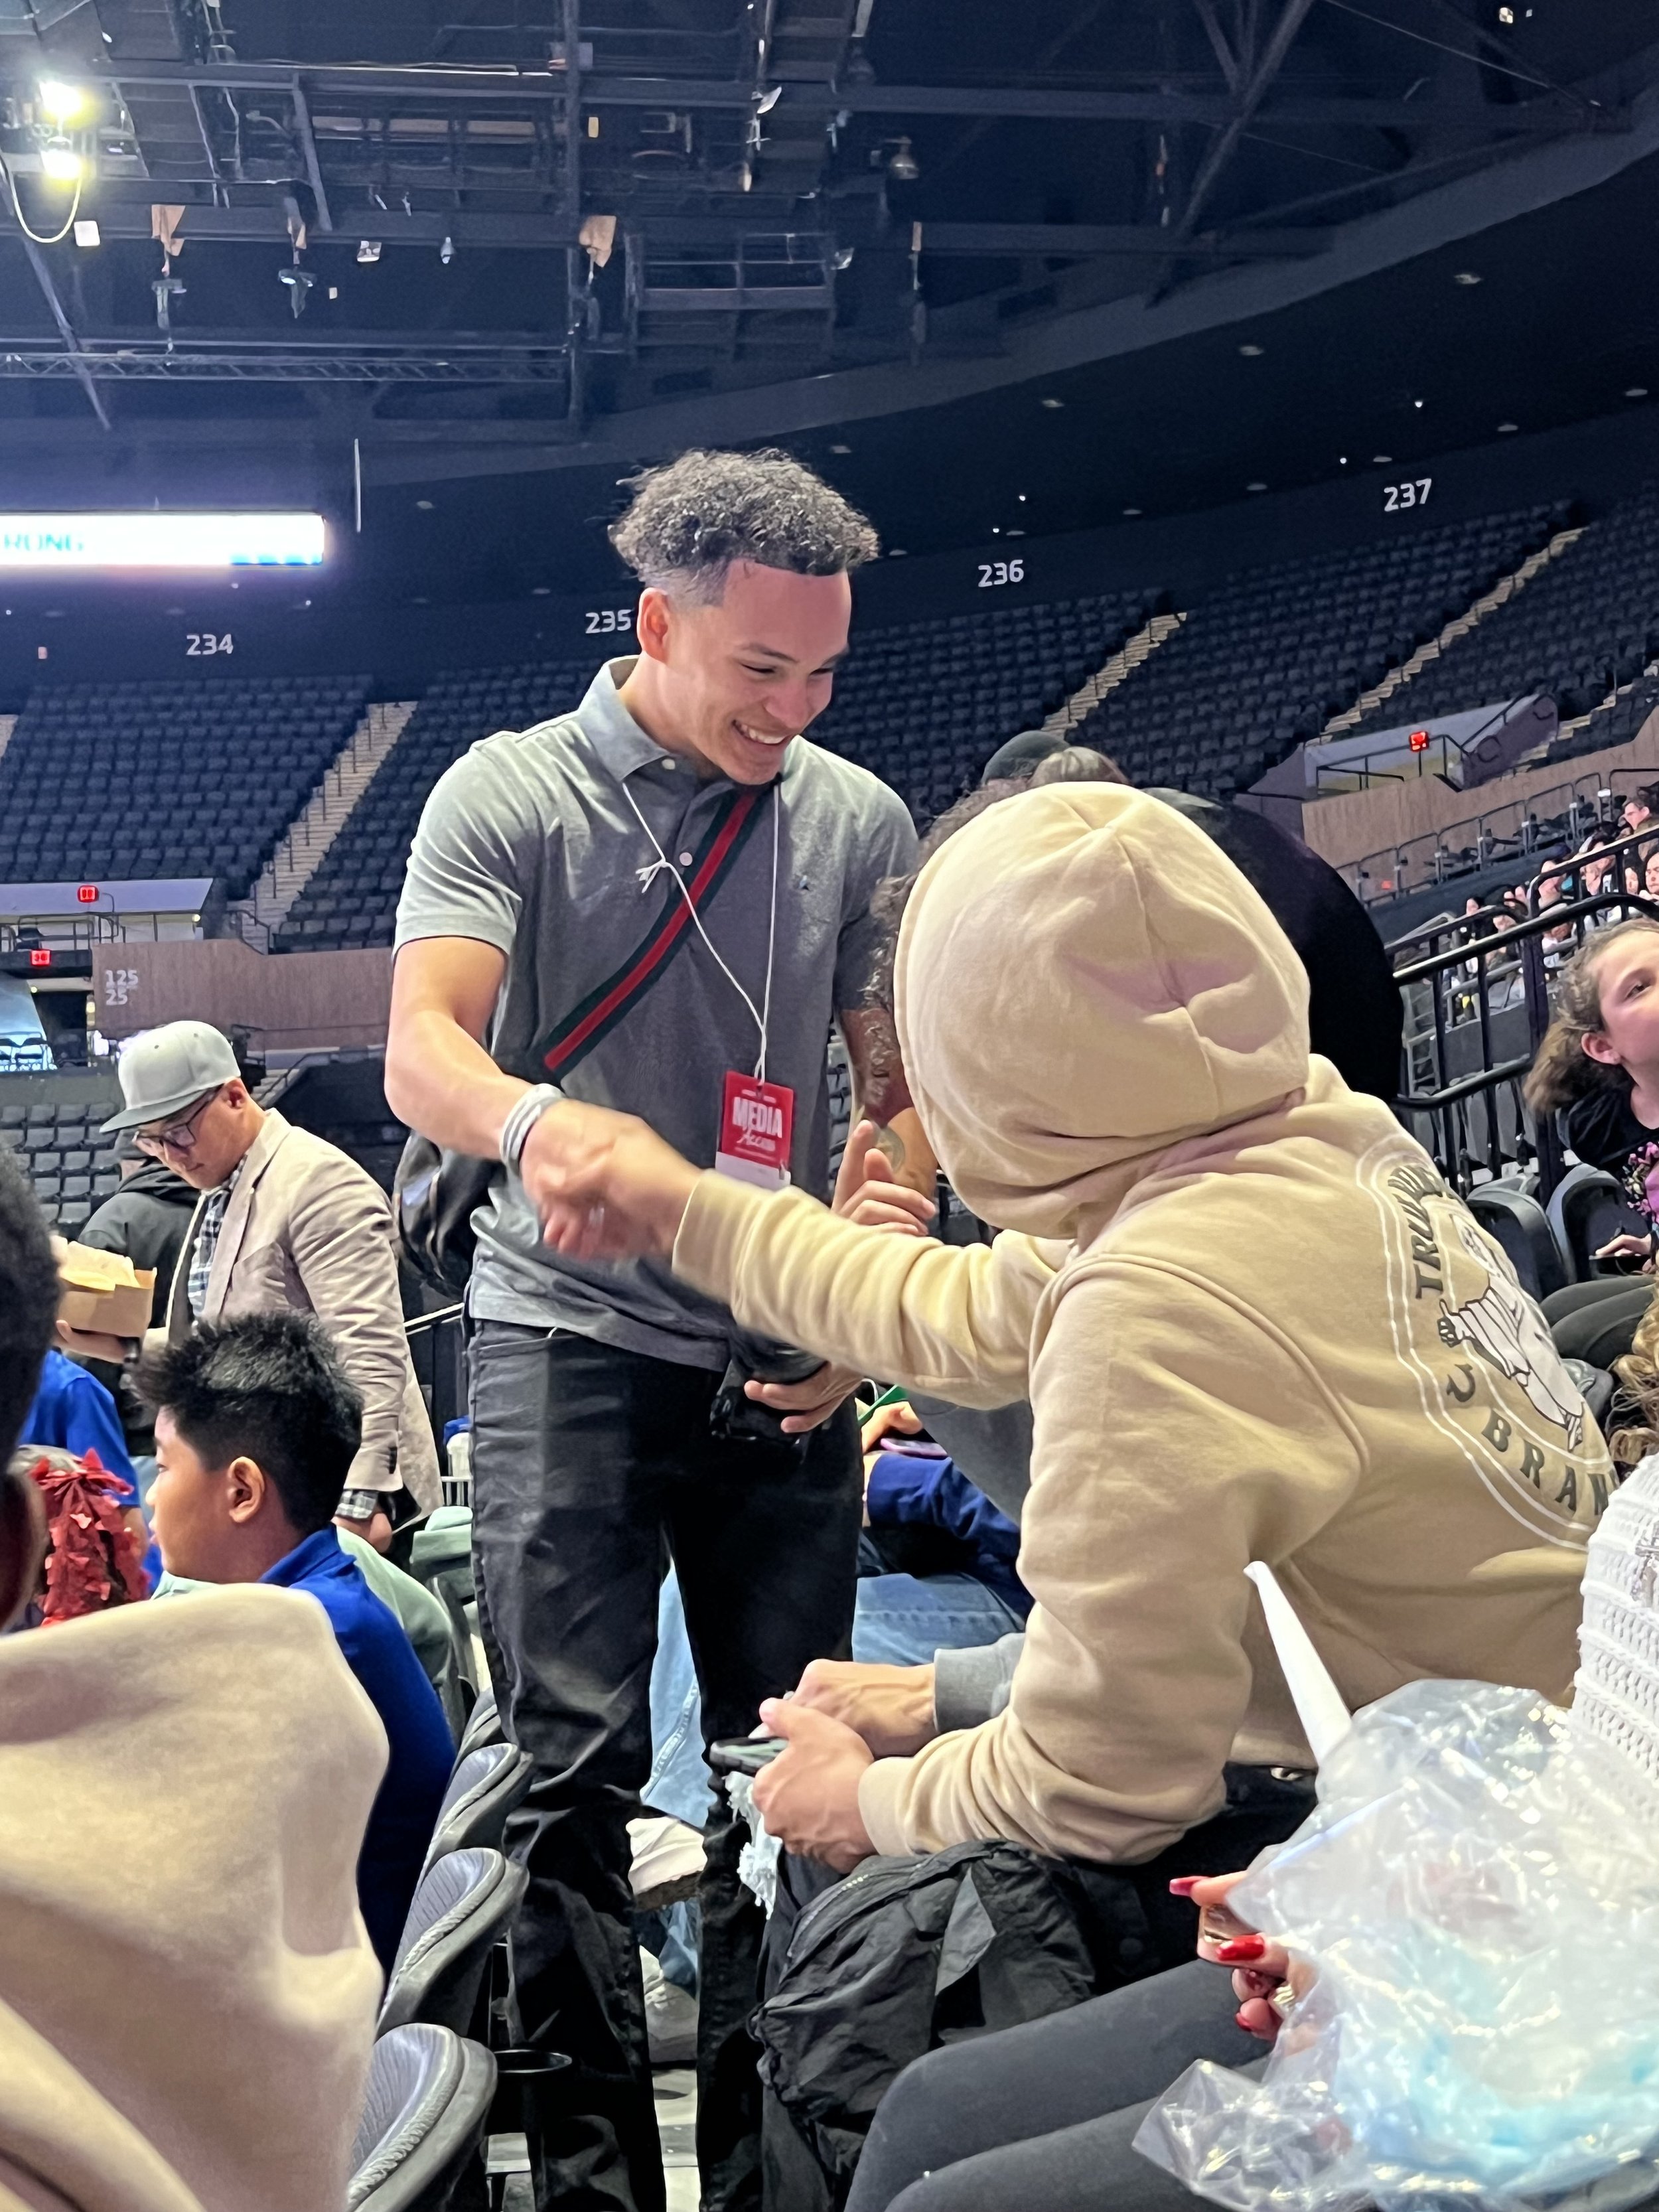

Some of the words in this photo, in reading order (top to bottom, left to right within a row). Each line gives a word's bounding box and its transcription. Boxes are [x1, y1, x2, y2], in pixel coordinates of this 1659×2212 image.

[1384, 478, 1431, 512] 237
[977, 559, 1024, 587] 236
[585, 609, 632, 634] 235
[186, 634, 234, 655] 234
[106, 970, 138, 988] 125
[106, 988, 127, 1005] 25
[732, 1096, 782, 1139] MEDIA
